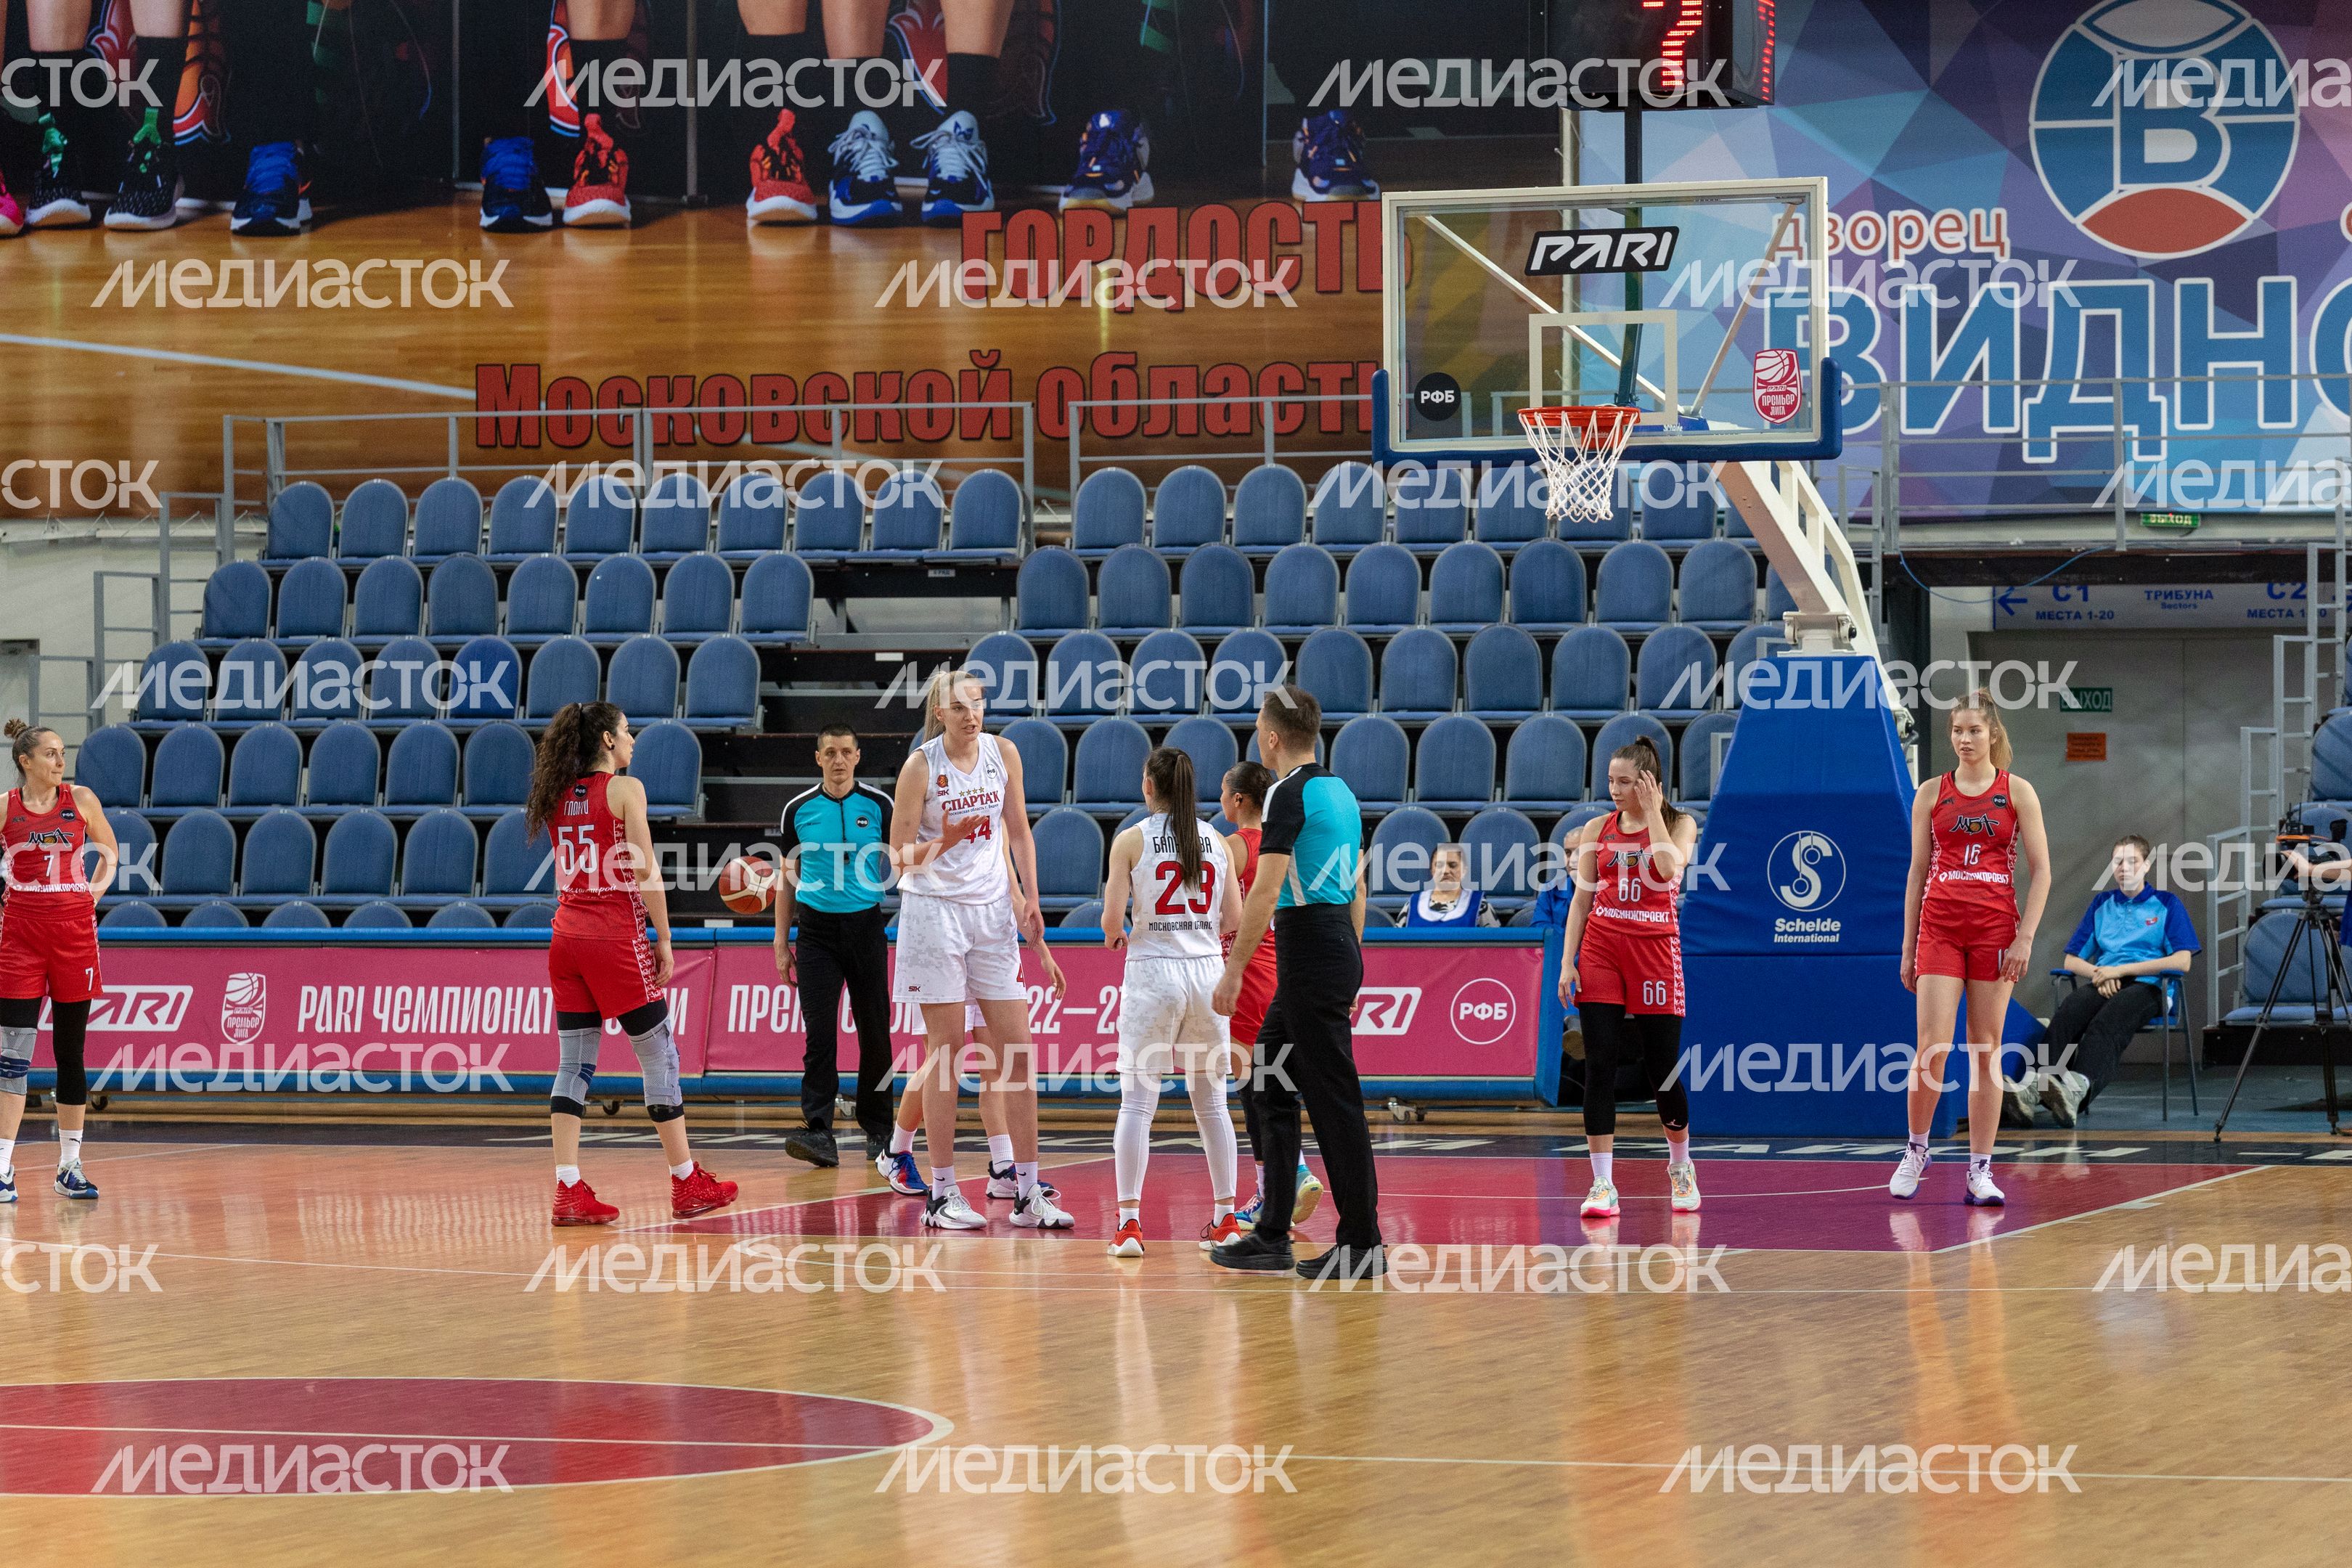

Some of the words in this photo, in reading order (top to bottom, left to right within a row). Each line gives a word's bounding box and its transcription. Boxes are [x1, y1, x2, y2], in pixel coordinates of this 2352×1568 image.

[1530, 232, 1673, 271] PARI
[475, 350, 1014, 449] Московской
[1421, 390, 1455, 404] РФБ
[2144, 589, 2213, 601] ТРИБУНА
[2035, 610, 2082, 620] МЕСТА
[2087, 610, 2114, 620] 1-20
[2247, 609, 2294, 618] МЕСТА
[942, 791, 1000, 812] СПАРТАК
[558, 825, 598, 875] 55
[1964, 844, 1982, 866] 16
[44, 854, 54, 877] 7
[1155, 860, 1216, 915] 23
[1619, 877, 1641, 902] 66
[1775, 918, 1842, 933] Schelde
[1773, 934, 1840, 943] International
[85, 968, 94, 992] 7
[1643, 980, 1667, 1005] 66
[87, 992, 185, 1026] ARI
[298, 985, 365, 1033] PARI
[373, 986, 555, 1034] ЧЕМПИОНАТ
[1459, 1003, 1508, 1020] РФБ
